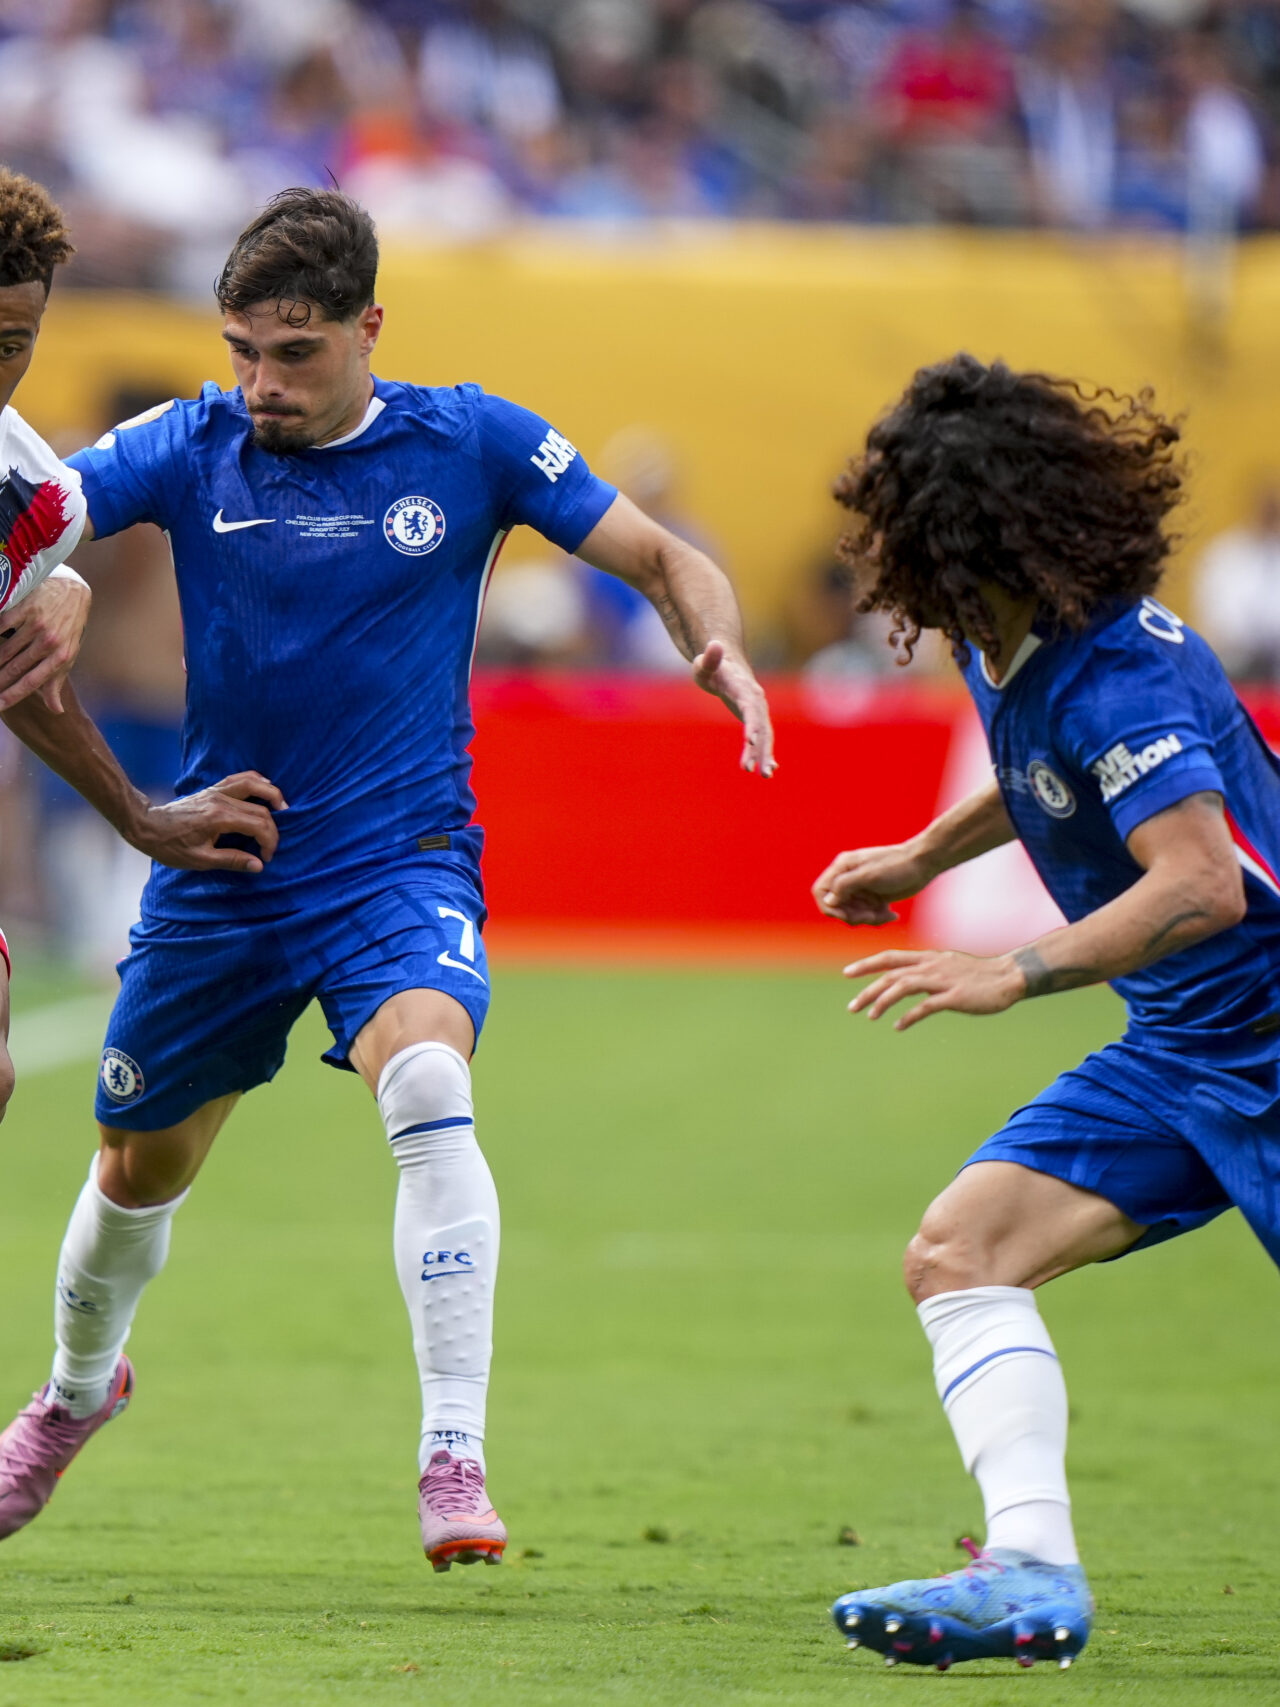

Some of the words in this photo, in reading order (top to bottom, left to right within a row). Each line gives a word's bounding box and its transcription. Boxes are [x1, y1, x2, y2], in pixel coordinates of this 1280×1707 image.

[542, 438, 578, 483] NATI
[393, 498, 433, 511] CHELSEA
[395, 541, 421, 552] FOOTBALL
[1099, 733, 1183, 803] NATION
[437, 906, 475, 963] 7
[422, 1250, 473, 1266] CFC
